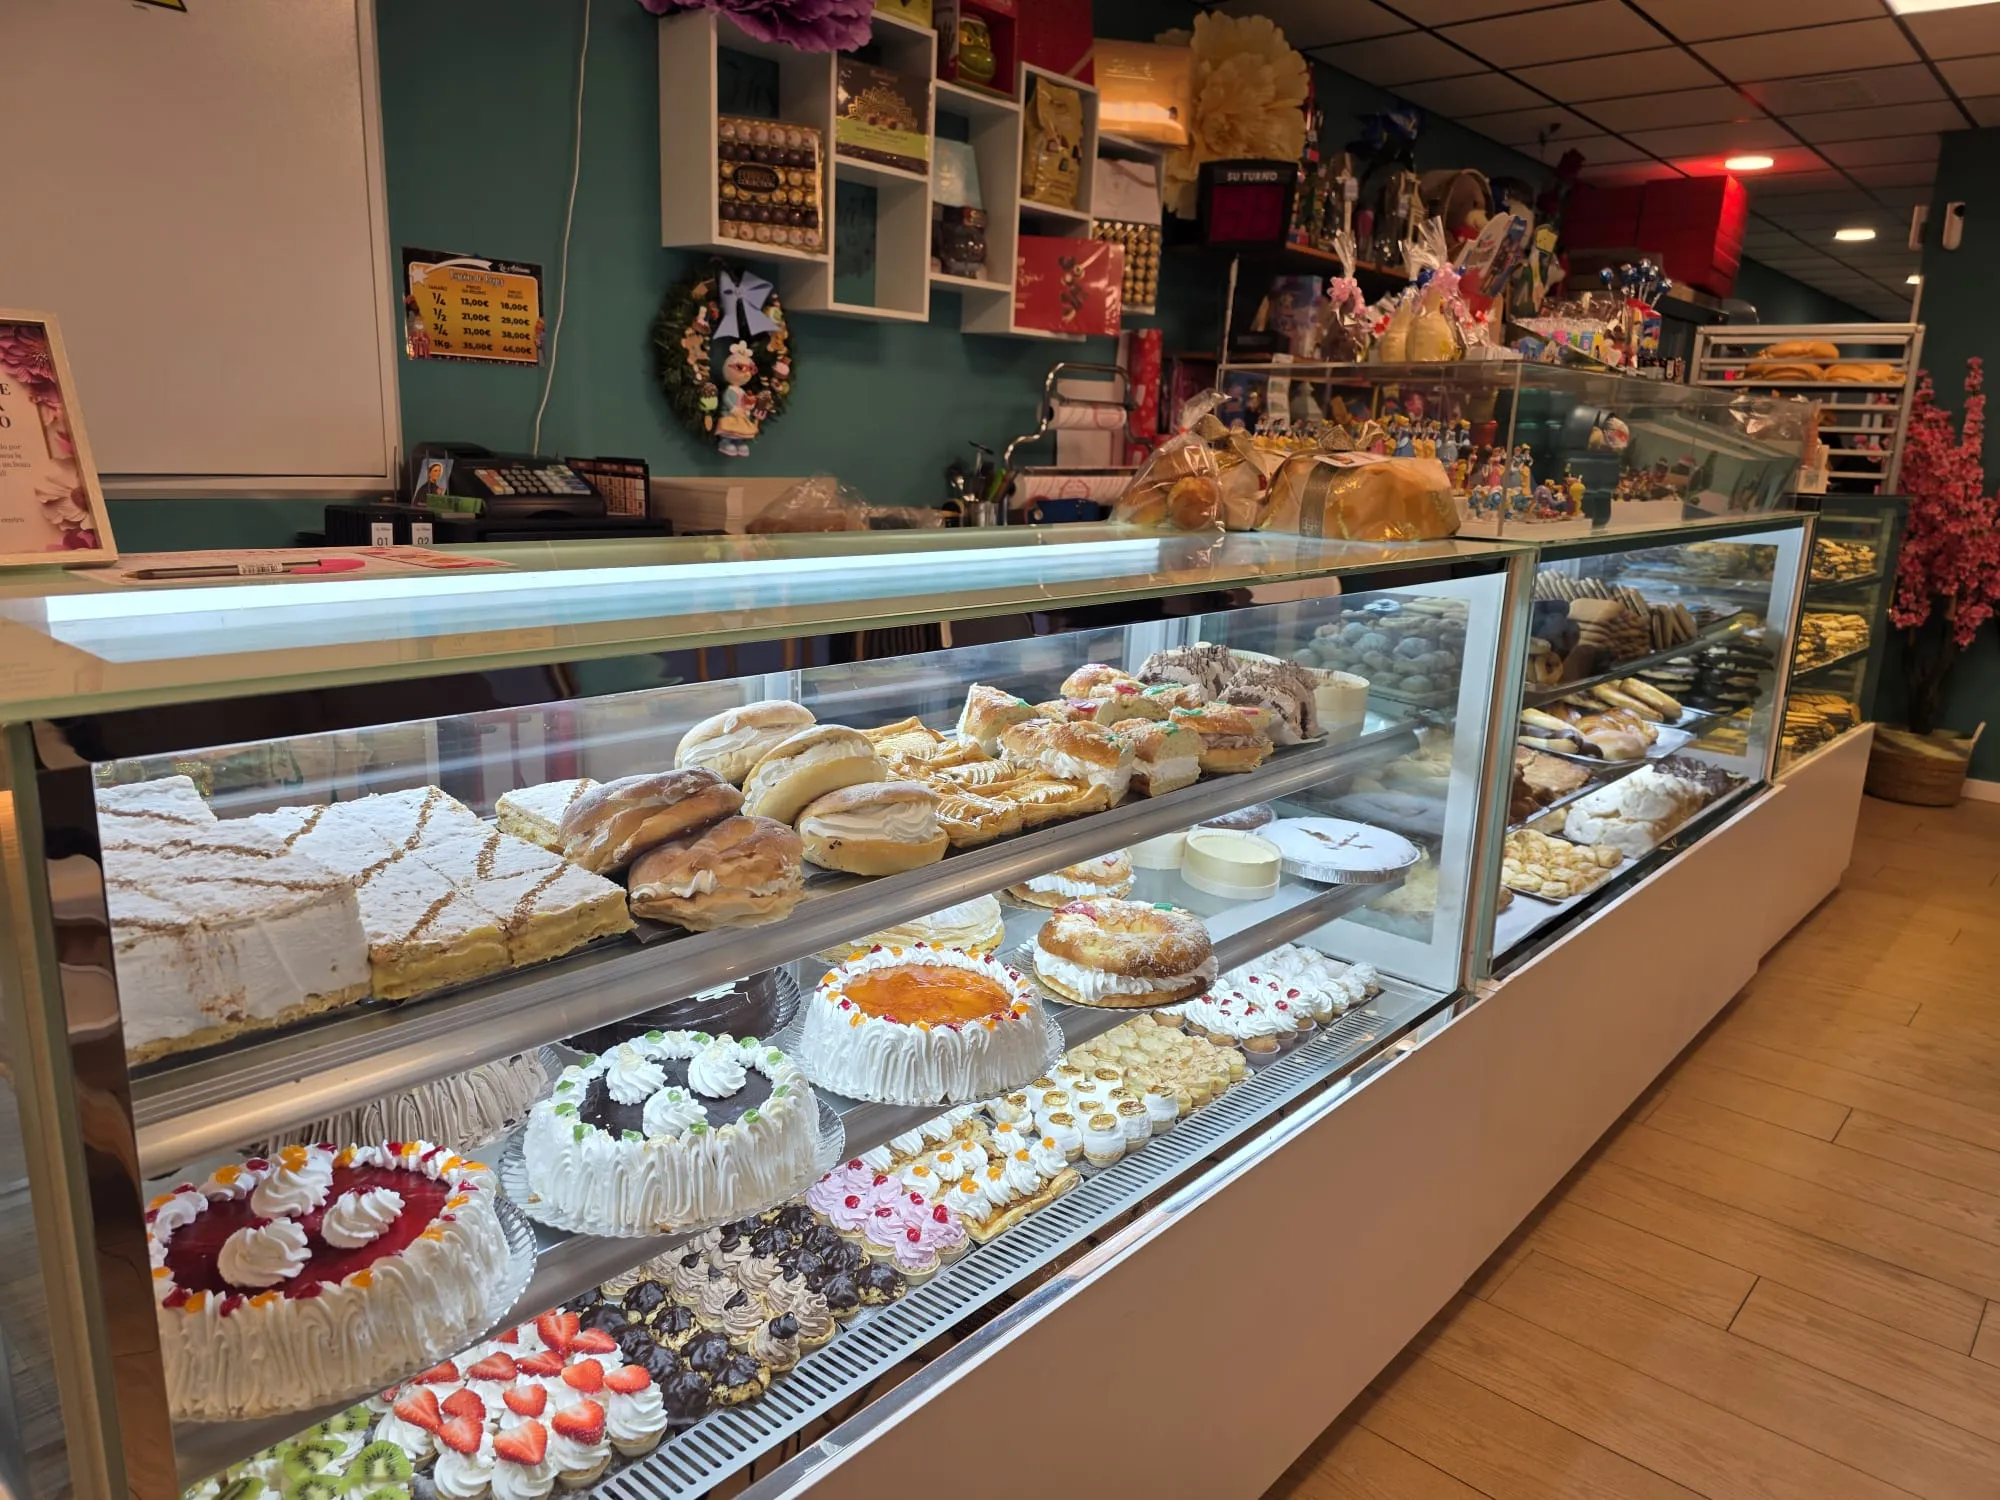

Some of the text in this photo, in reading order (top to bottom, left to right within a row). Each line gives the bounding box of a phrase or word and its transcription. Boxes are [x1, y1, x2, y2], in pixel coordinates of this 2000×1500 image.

[1226, 171, 1278, 182] SU TURNO
[432, 292, 447, 306] 1/4
[433, 308, 448, 322] 1/2
[461, 313, 491, 322] 21,00€
[433, 323, 449, 337] 3/4
[463, 328, 491, 337] 31,00€
[377, 537, 388, 546] 01
[417, 537, 429, 545] 02
